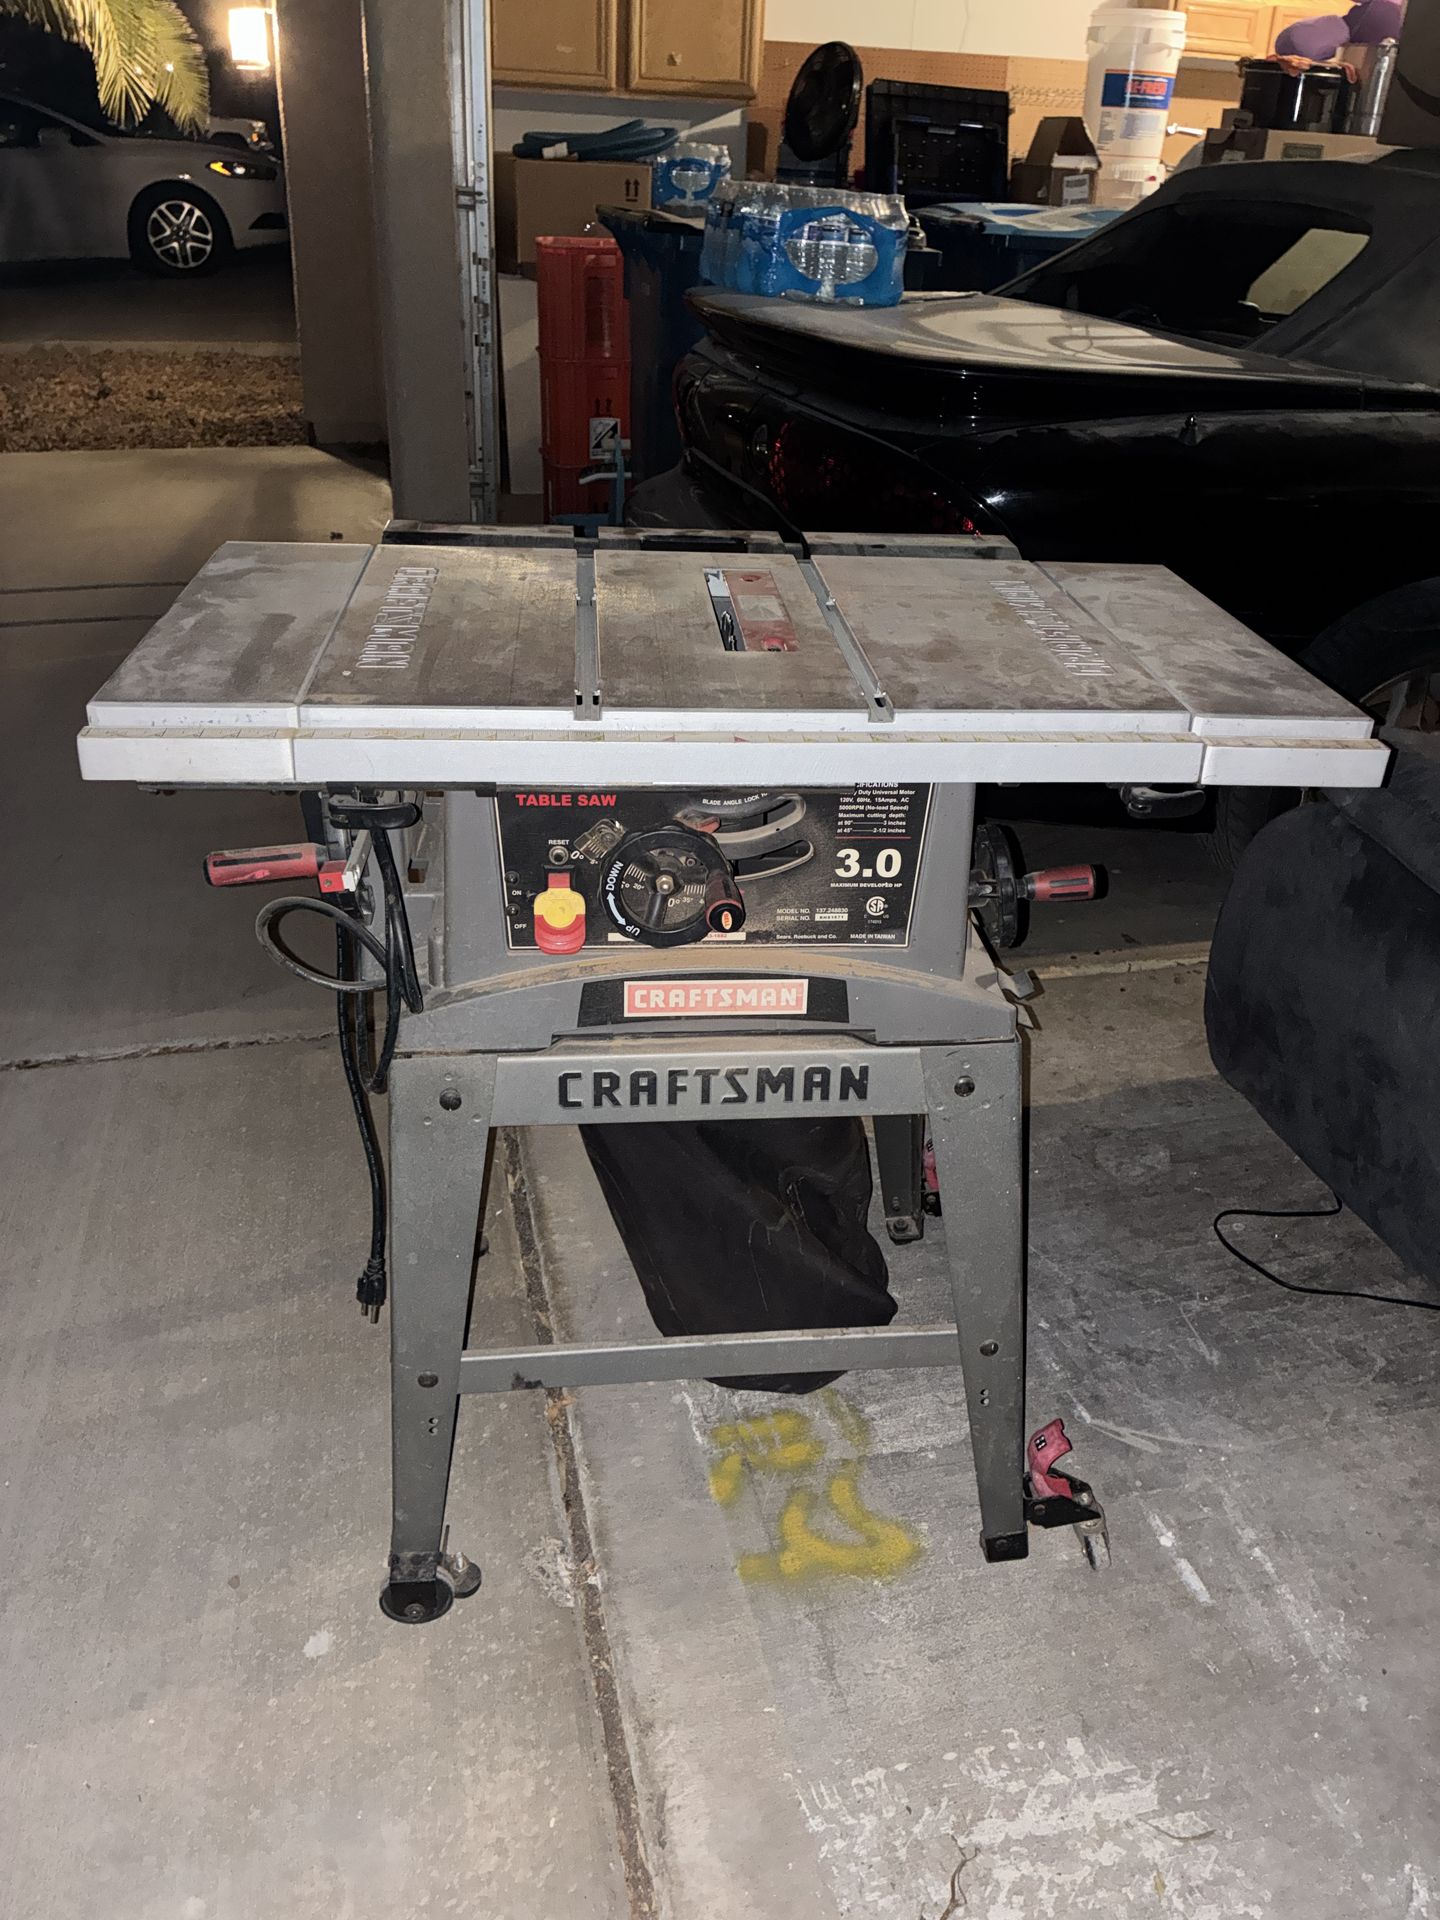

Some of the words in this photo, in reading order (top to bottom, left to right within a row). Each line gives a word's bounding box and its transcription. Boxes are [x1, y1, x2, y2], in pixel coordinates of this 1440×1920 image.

[356, 566, 440, 669] CRAFTSMAN
[515, 794, 572, 806] TABLE
[577, 794, 616, 806] SAW
[744, 794, 760, 803] LOCK
[606, 861, 624, 890] DOWN
[834, 848, 902, 878] 3.0
[626, 925, 640, 936] UP
[634, 986, 797, 1009] CRAFTSMAN
[558, 1065, 869, 1108] CRAFTSMAN
